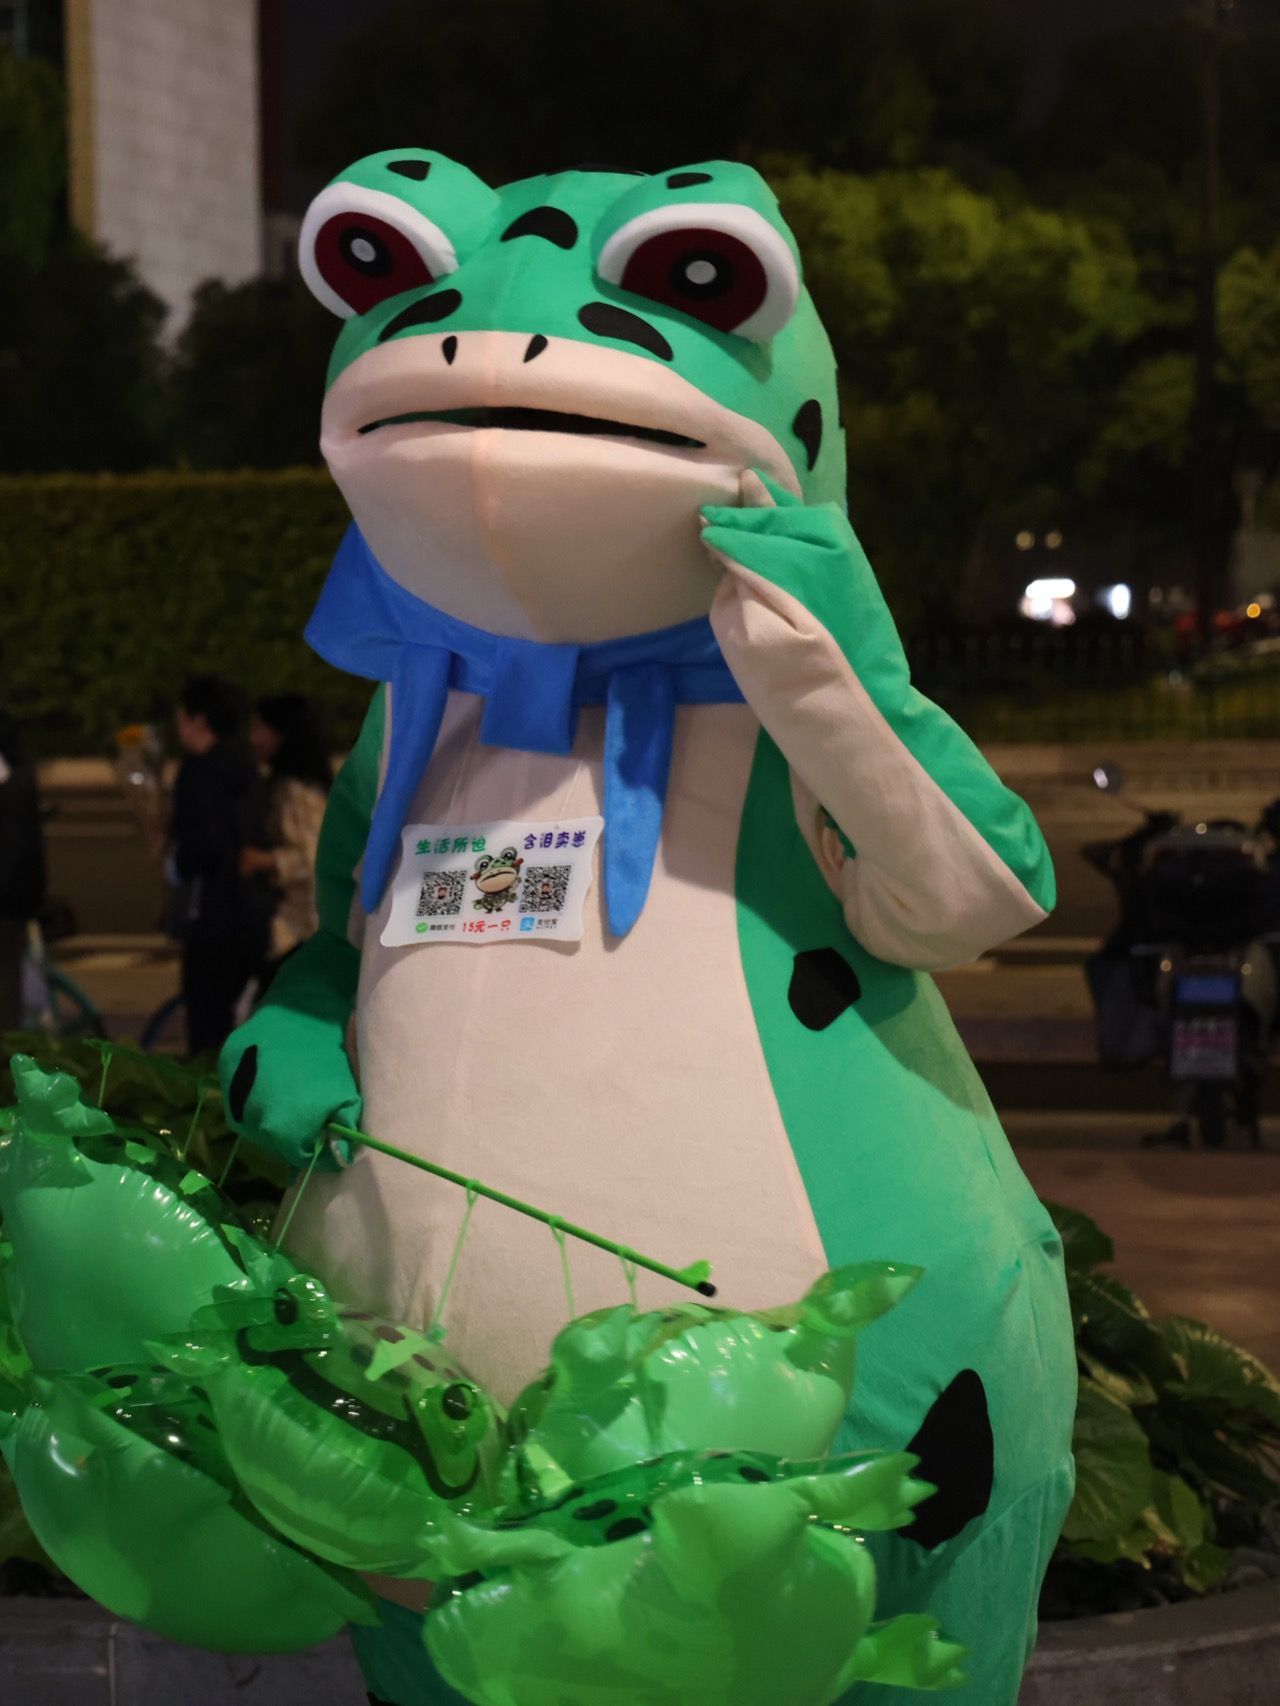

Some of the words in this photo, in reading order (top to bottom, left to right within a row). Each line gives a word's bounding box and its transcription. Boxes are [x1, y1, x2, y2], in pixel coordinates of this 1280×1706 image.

[523, 830, 587, 850] 含泪卖崽
[462, 919, 512, 933] 15元一只
